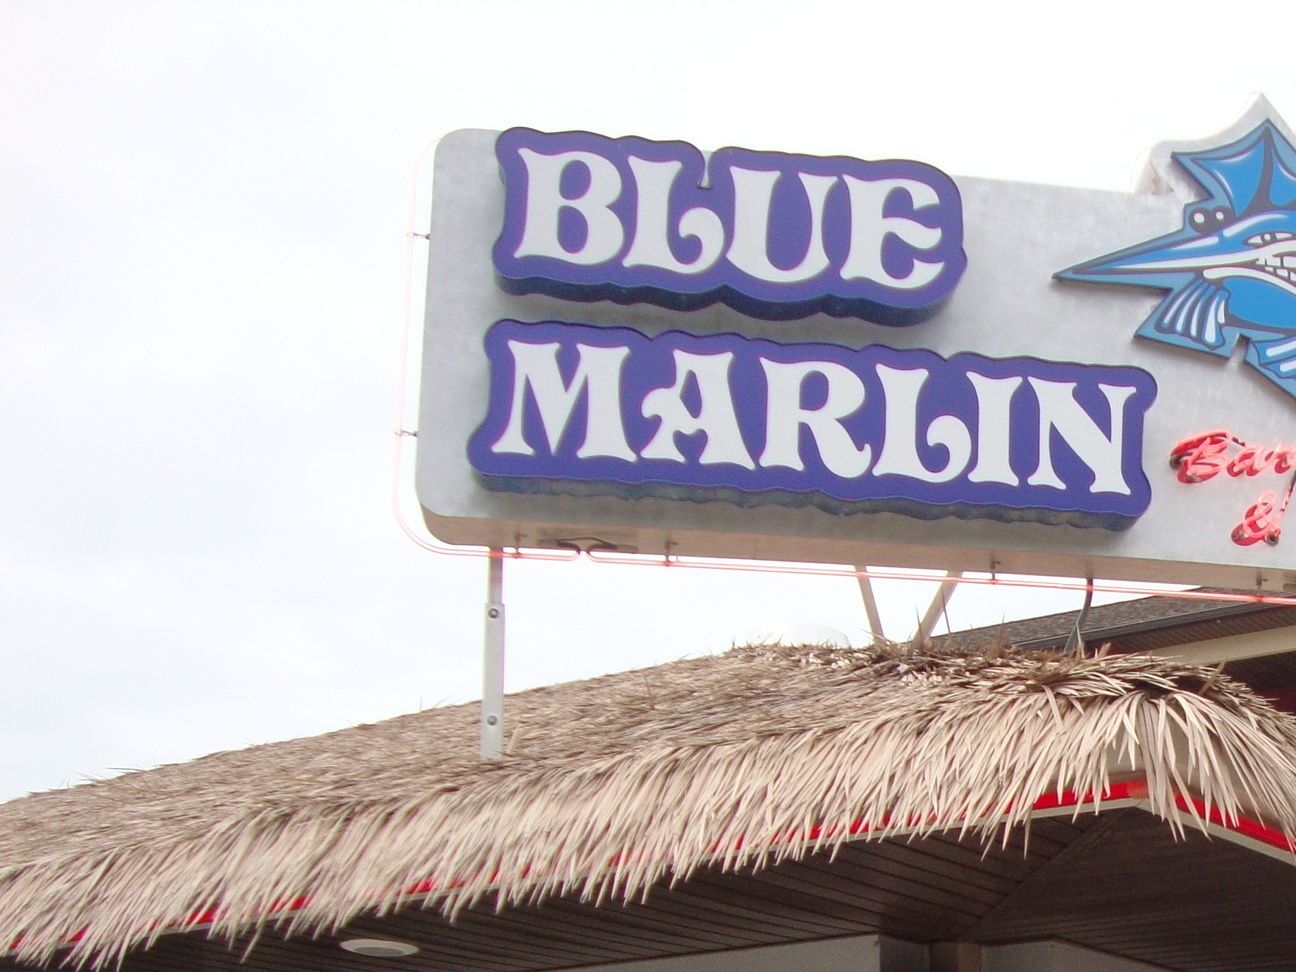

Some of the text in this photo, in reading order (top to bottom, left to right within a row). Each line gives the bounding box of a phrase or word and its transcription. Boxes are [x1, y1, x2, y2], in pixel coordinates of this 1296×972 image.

[512, 145, 945, 287] BLUE
[491, 338, 1139, 496] MARLIN
[1230, 493, 1282, 547] &
